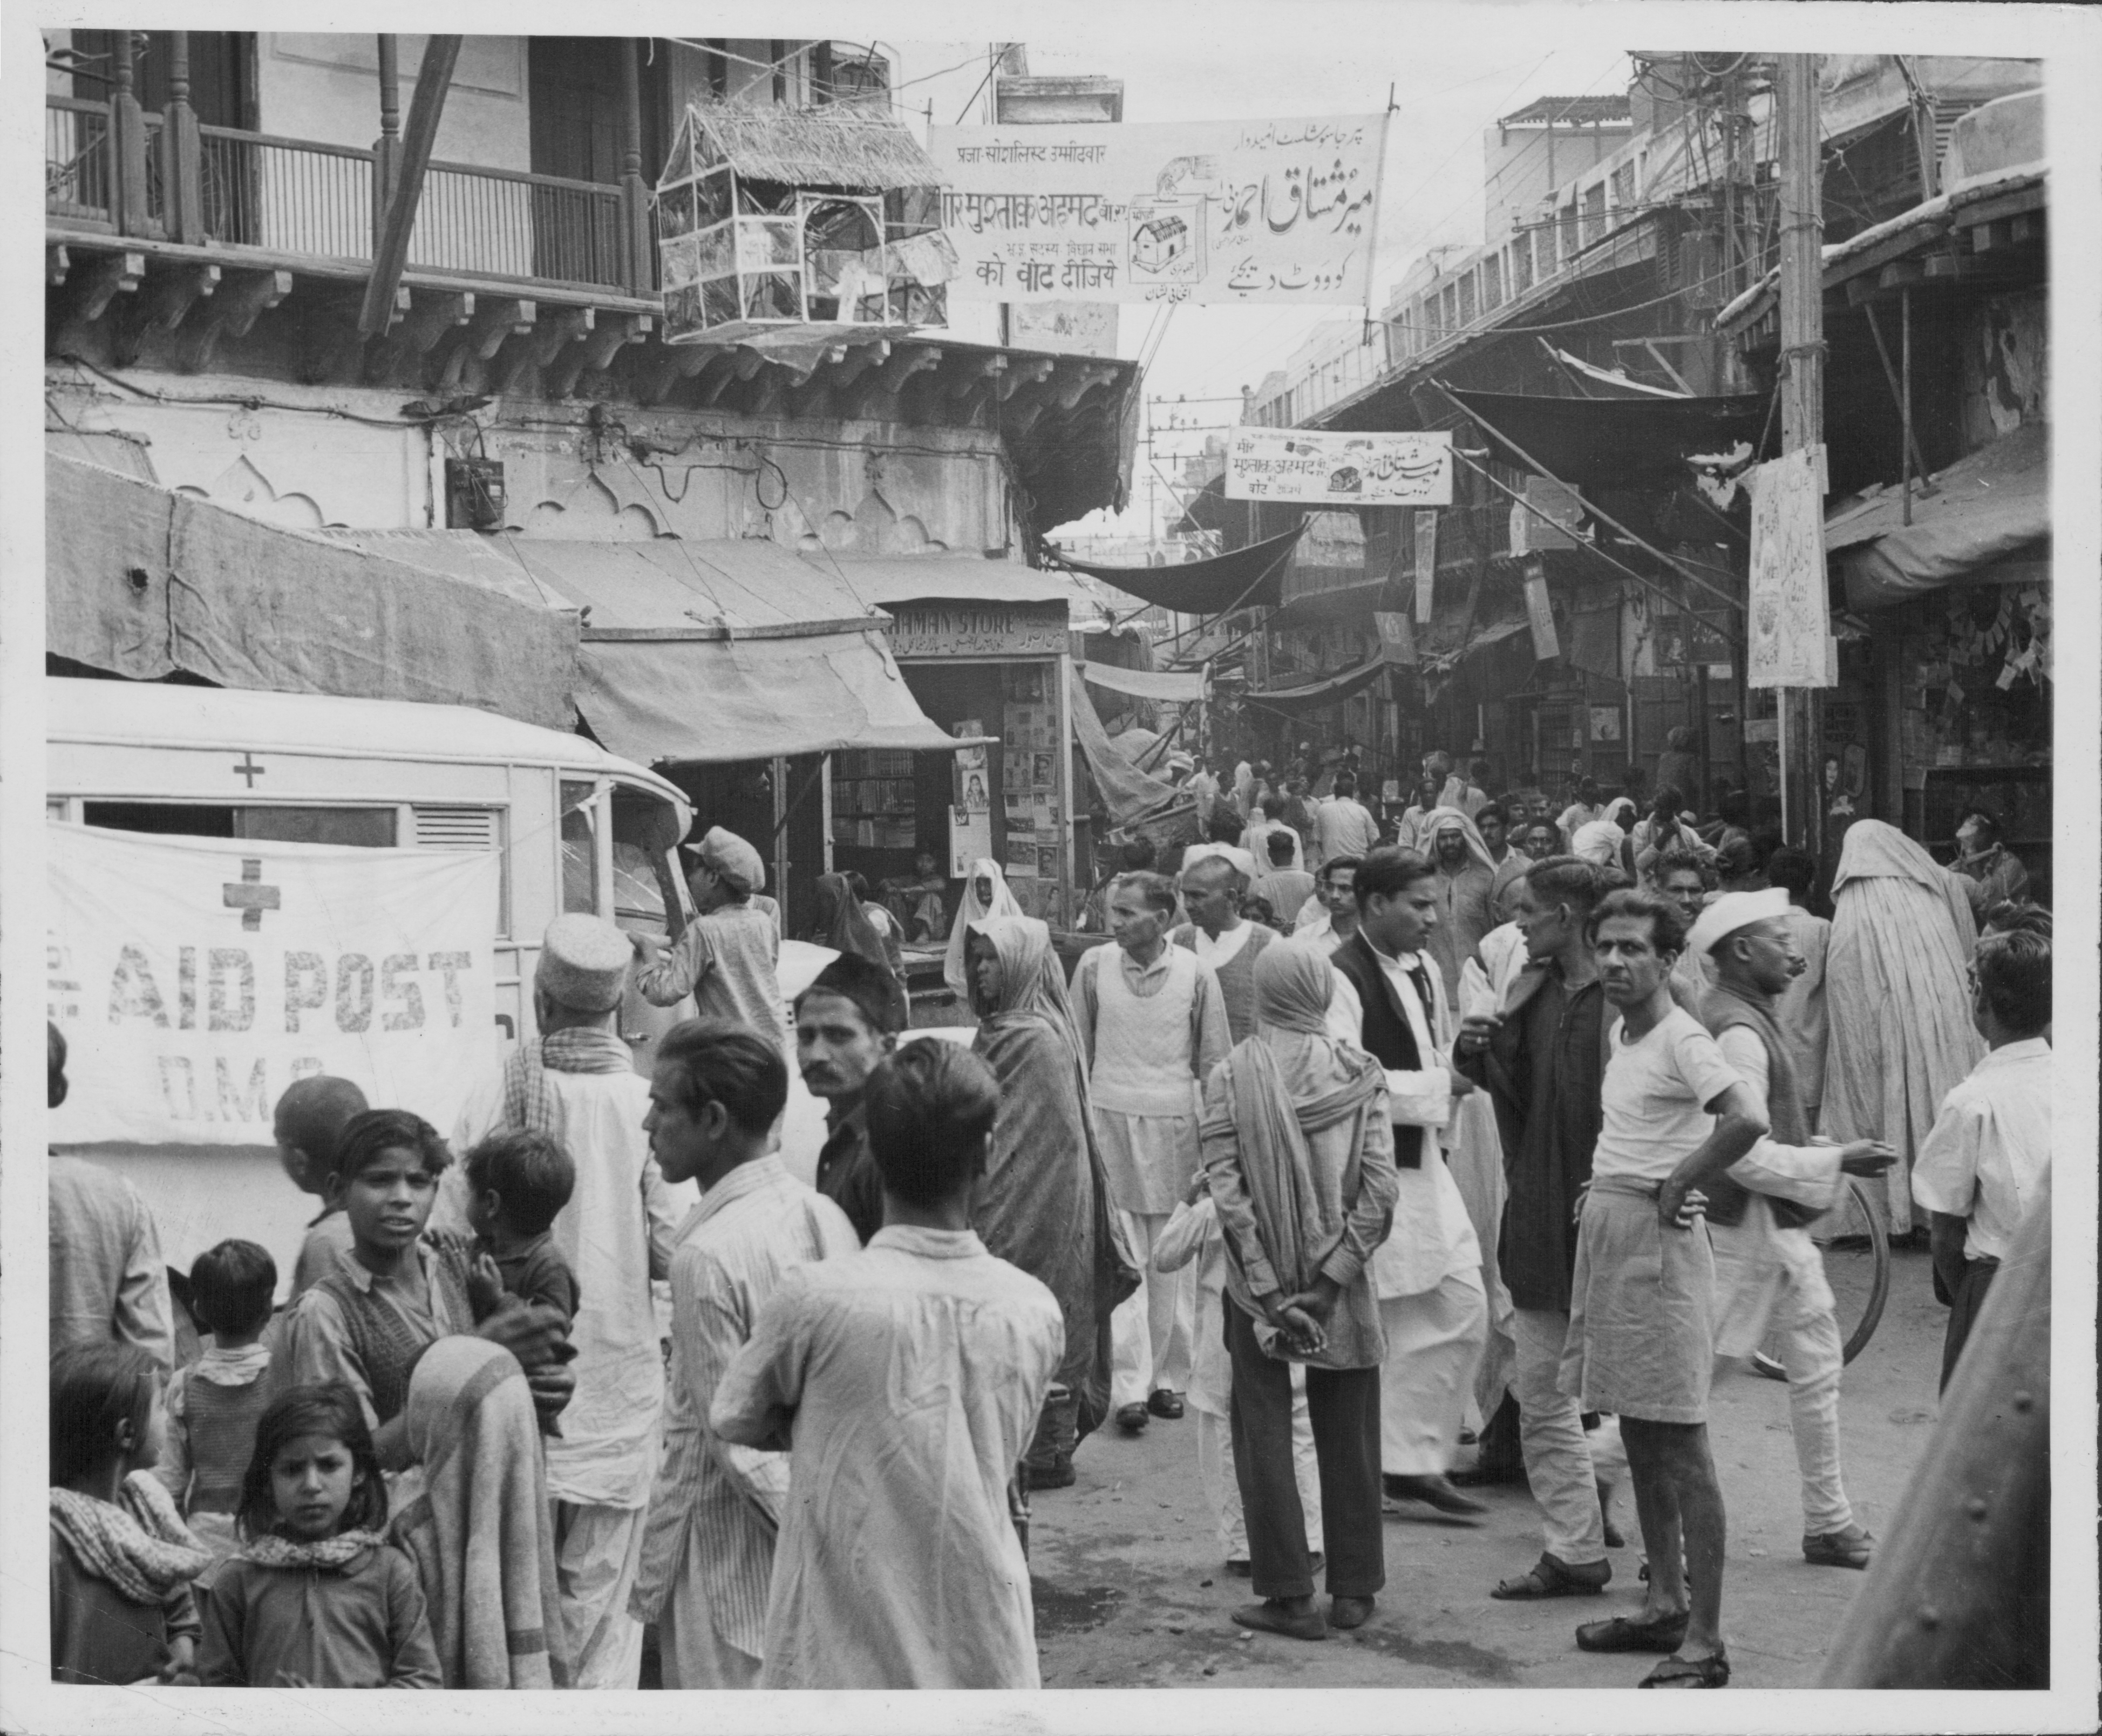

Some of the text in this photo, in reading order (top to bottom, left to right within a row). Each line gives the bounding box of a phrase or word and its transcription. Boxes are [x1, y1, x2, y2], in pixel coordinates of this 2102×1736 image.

[1050, 140, 1107, 164] उम्मीदवार
[1036, 193, 1103, 229] अहमद
[1098, 242, 1117, 256] सभा
[976, 251, 1119, 292] को वोट दीजिये
[1235, 438, 1256, 453] मीर
[1274, 459, 1316, 475] अहमद
[1249, 479, 1268, 494] वोट
[957, 610, 1015, 635] STORE
[108, 944, 256, 1032] AID
[284, 950, 472, 1033] POST
